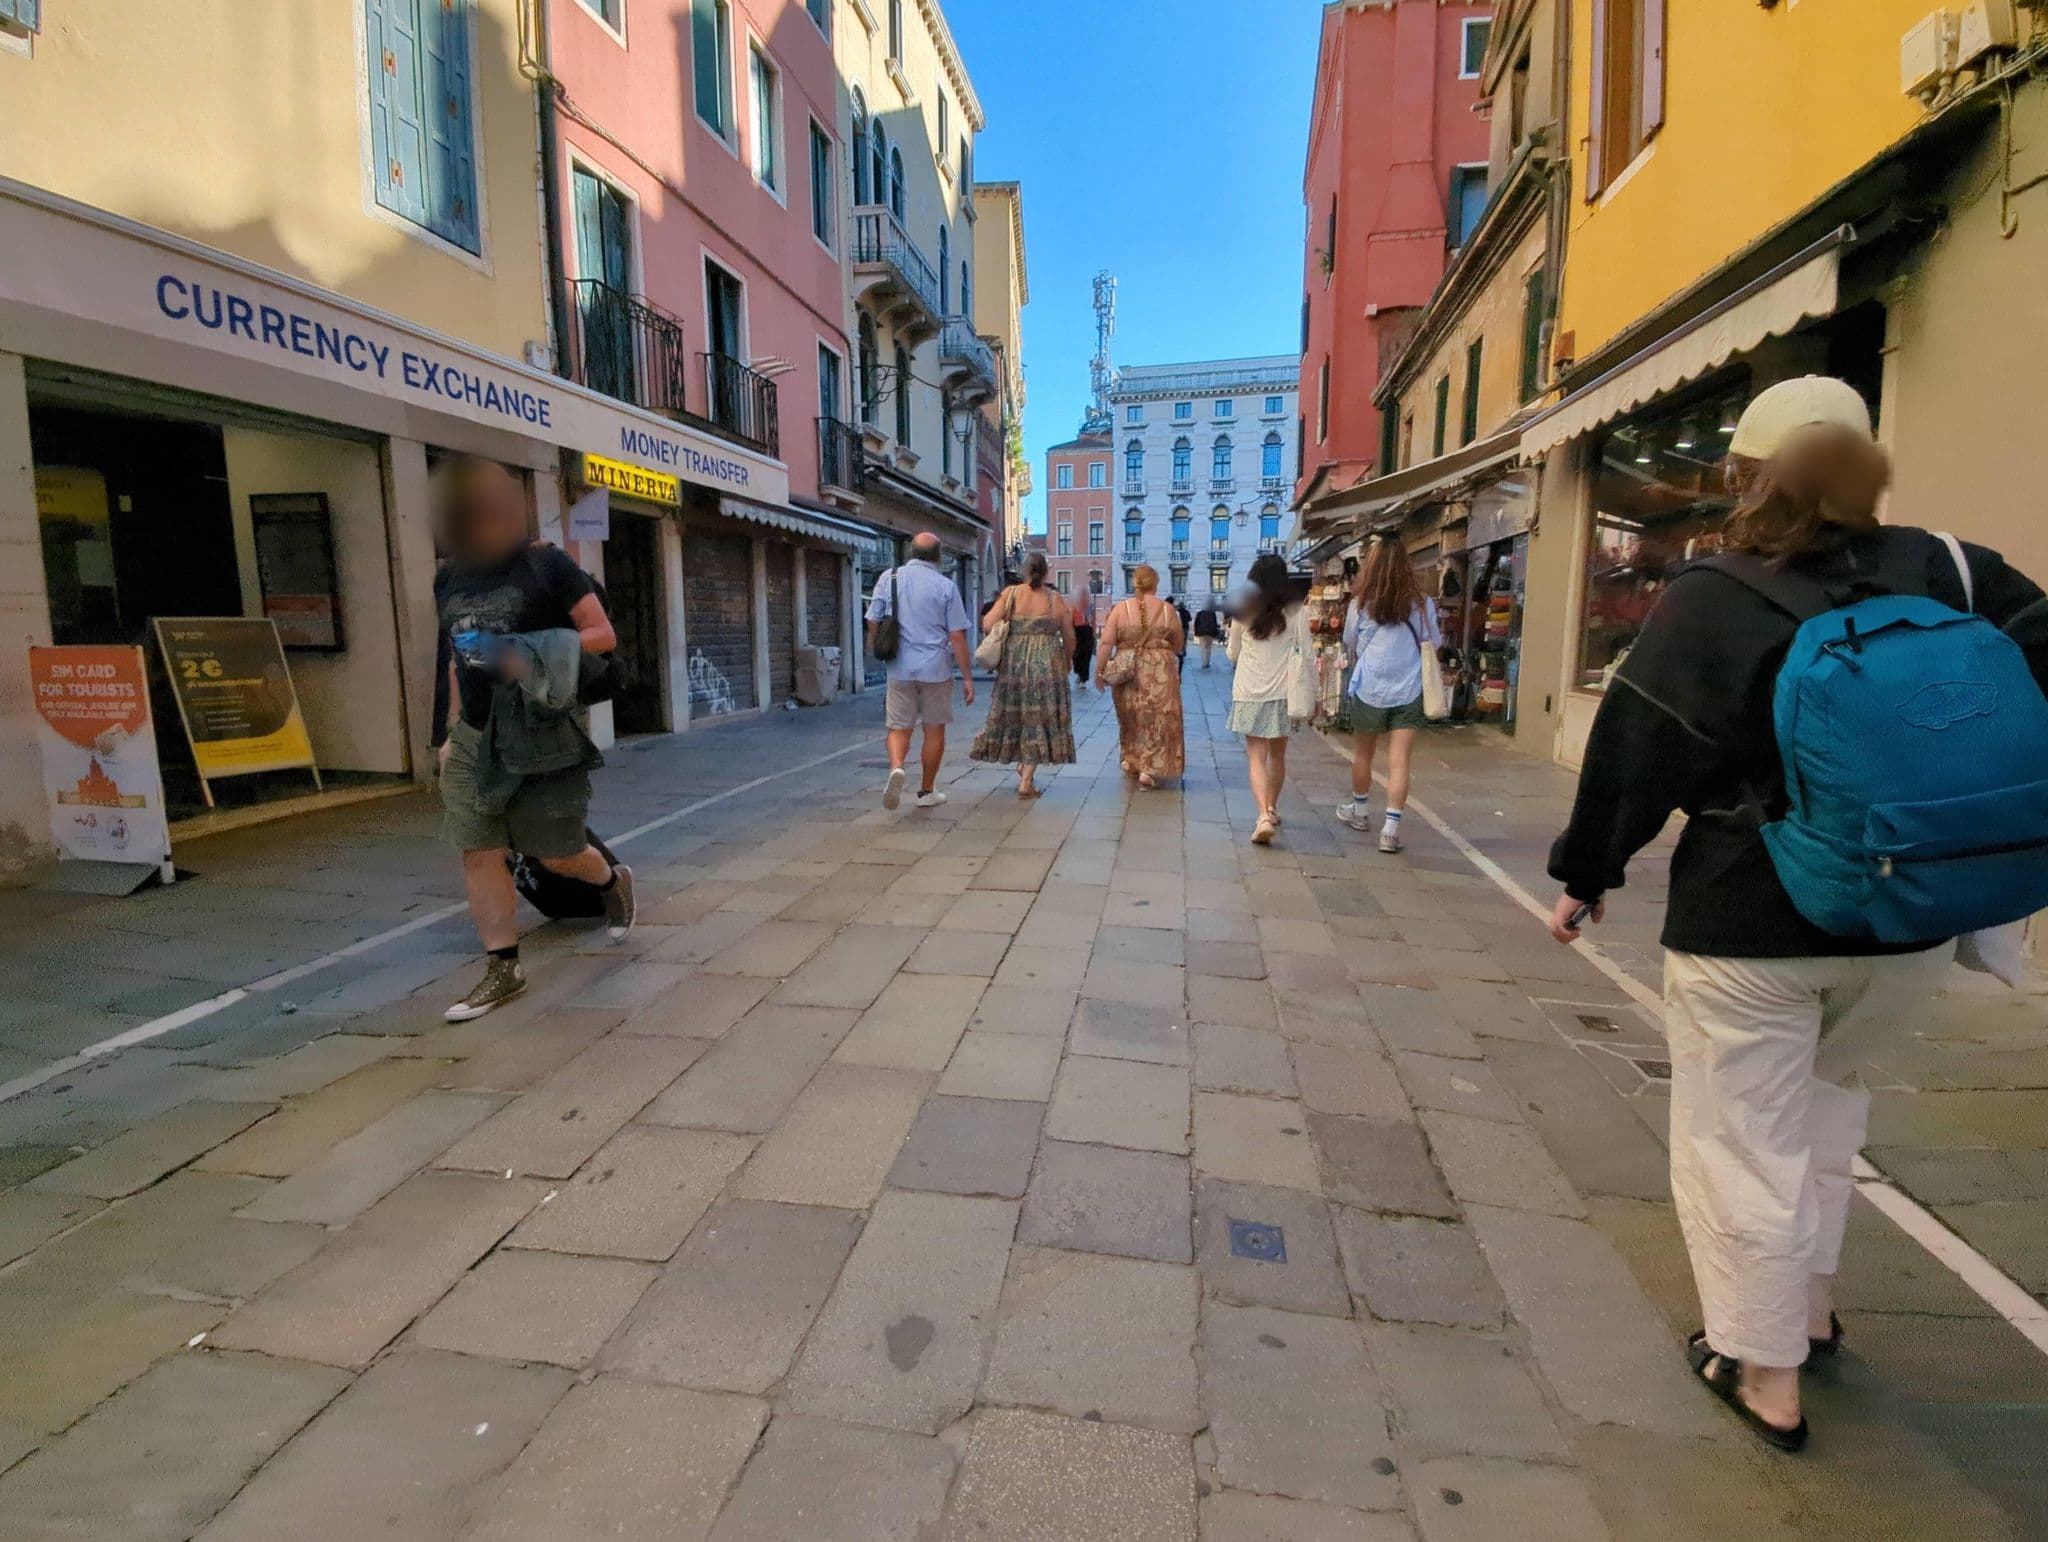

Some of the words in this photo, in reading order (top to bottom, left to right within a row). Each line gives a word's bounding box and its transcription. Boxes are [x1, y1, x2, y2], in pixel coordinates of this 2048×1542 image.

[156, 275, 390, 379] CURRENCY
[402, 352, 552, 428] EXCHANGE
[621, 426, 680, 466] MONEY
[682, 447, 749, 487] TRANSFER
[588, 461, 677, 502] MINERVA
[39, 681, 64, 697] FOR
[66, 681, 136, 698] TOURISTS
[51, 664, 74, 678] SIM
[76, 663, 116, 679] CARD
